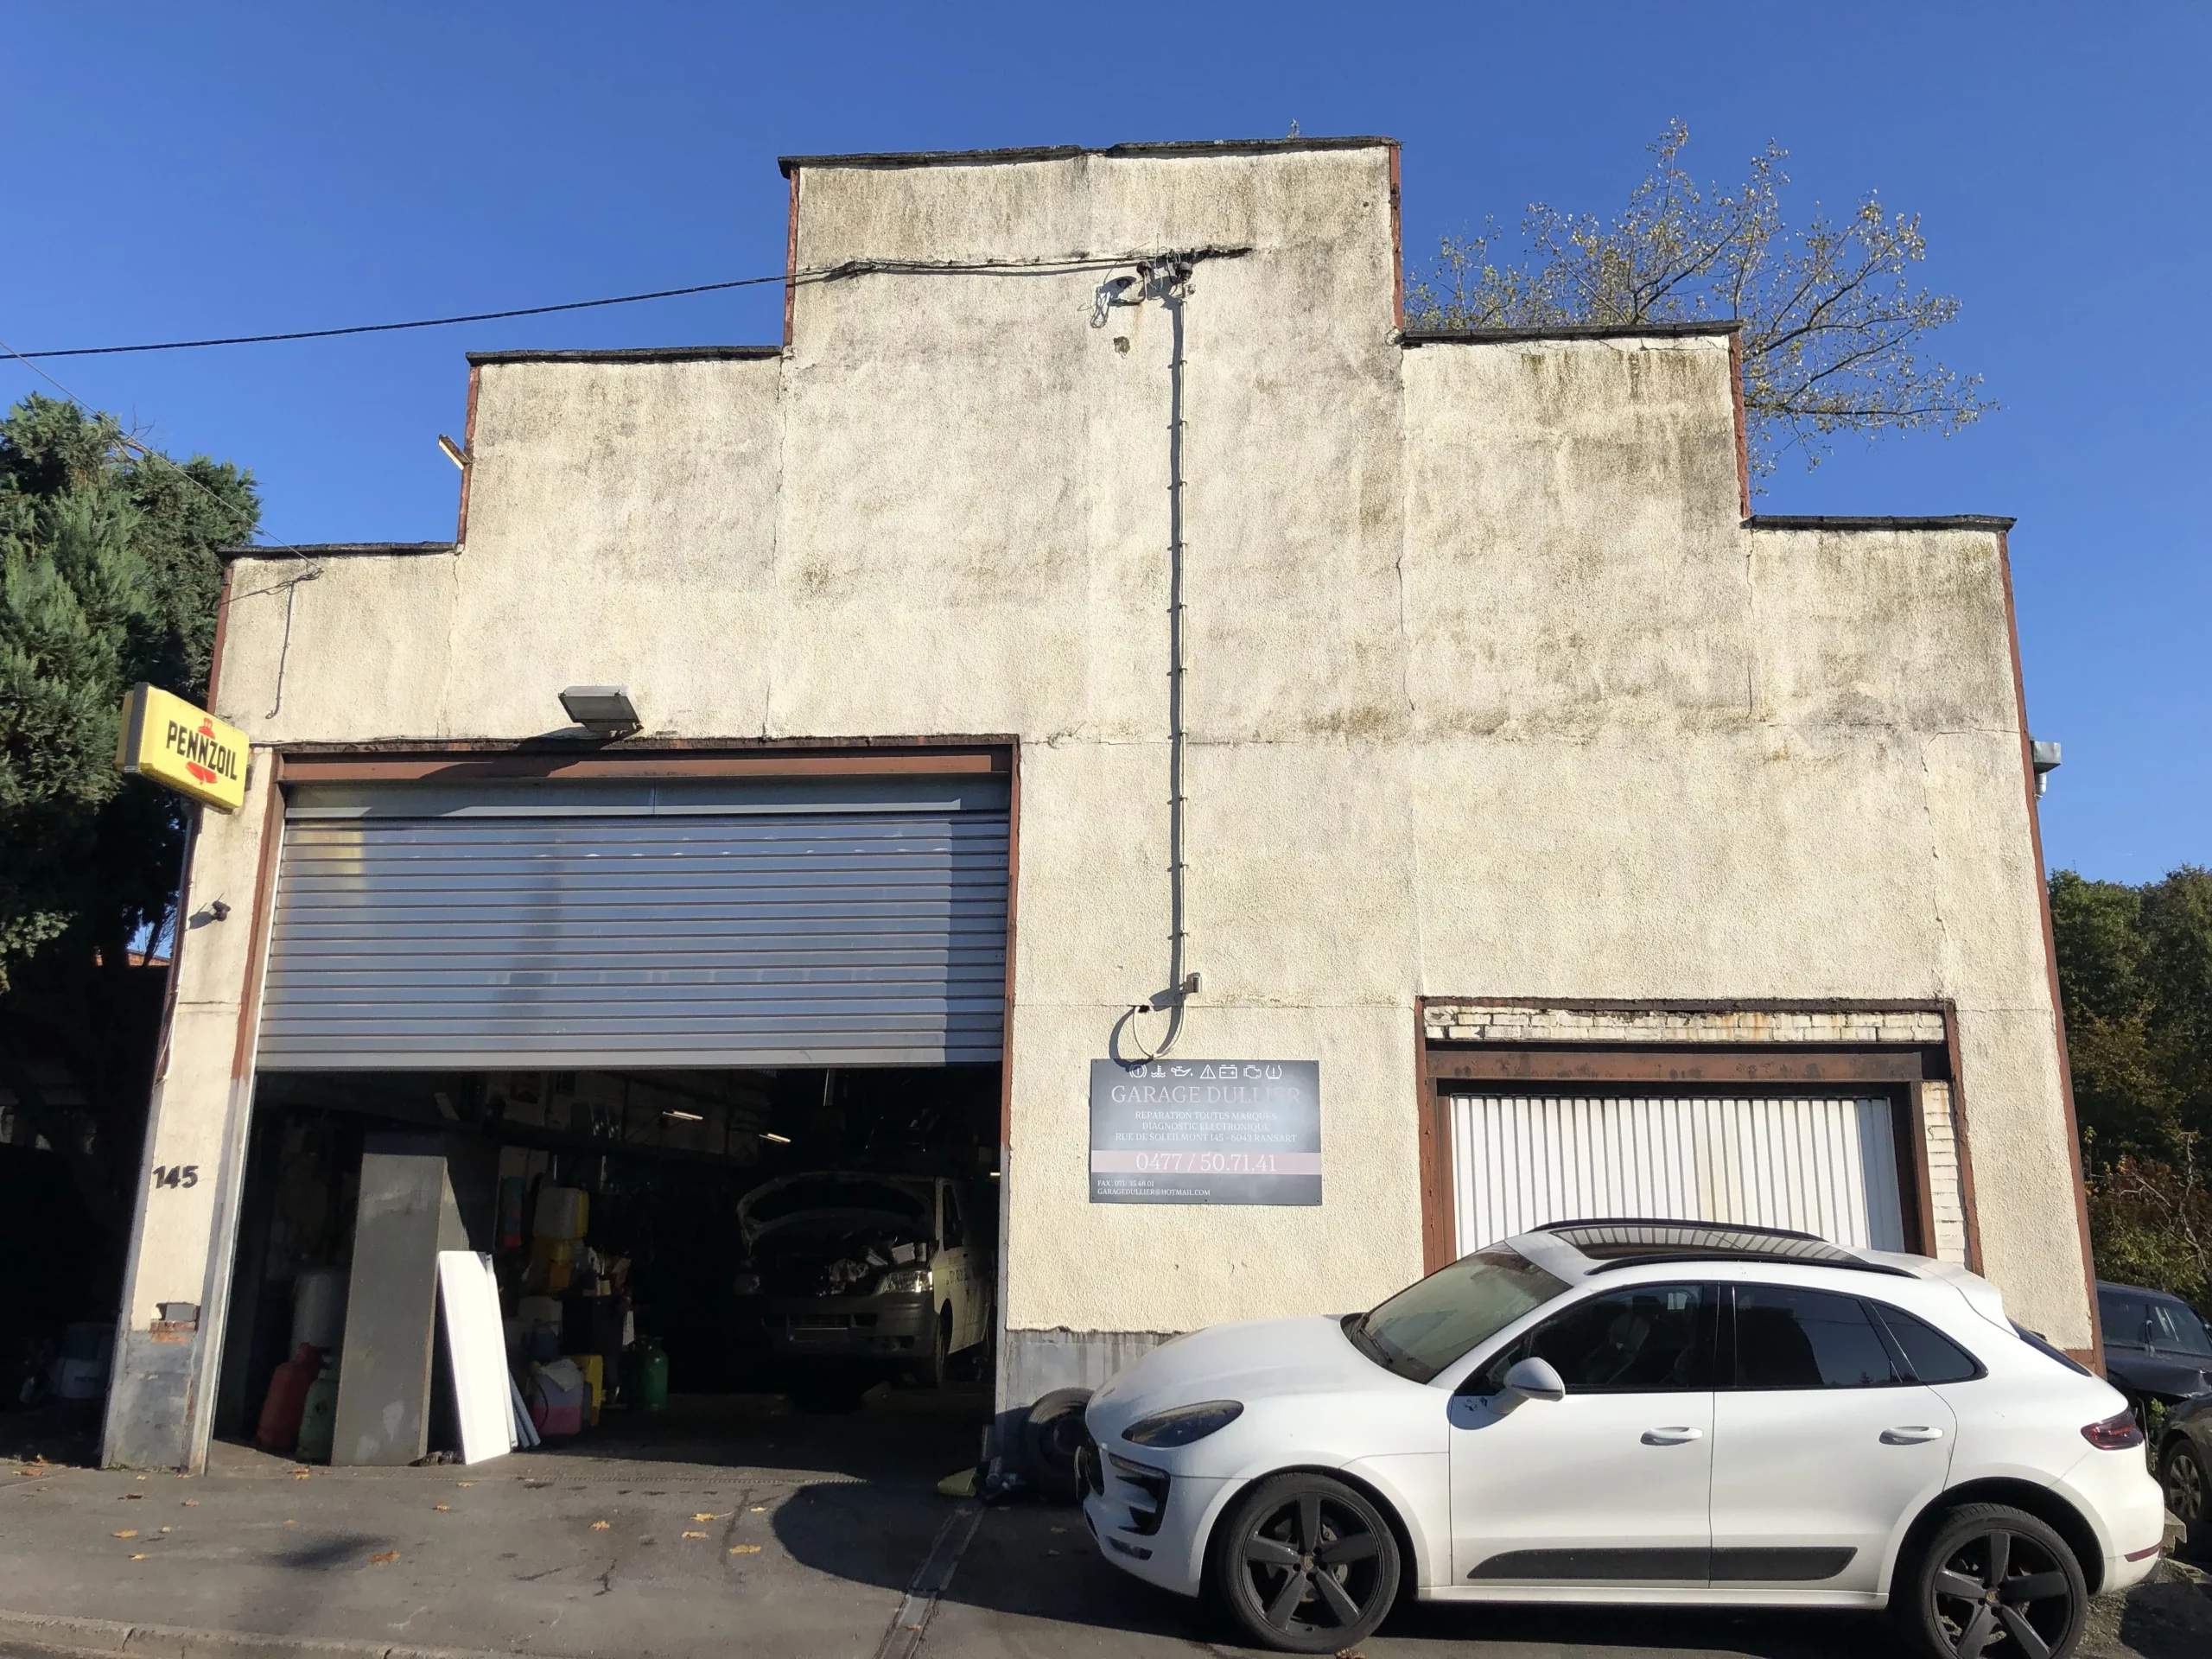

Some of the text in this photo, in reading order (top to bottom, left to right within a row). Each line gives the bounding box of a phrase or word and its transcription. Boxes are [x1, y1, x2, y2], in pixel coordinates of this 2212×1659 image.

[165, 720, 238, 781] PENNZOIL
[1111, 1085, 1201, 1103] GARAGE
[1135, 1110, 1277, 1122] REPARATION TOUTES MARQUES
[1141, 1122, 1198, 1132] DIAGNOSTIC
[1116, 1132, 1134, 1141] RUE
[1135, 1132, 1147, 1141] DE
[1149, 1132, 1208, 1142] SOLEILMONT
[1211, 1133, 1224, 1142] 145
[1230, 1133, 1252, 1142] 6043
[1254, 1134, 1297, 1143] RANSART
[1135, 1151, 1277, 1173] 0477 / 50.71.41
[152, 1165, 200, 1190] 145
[1097, 1188, 1211, 1197] GARAGEDULLIER@HOTMAIL.COM
